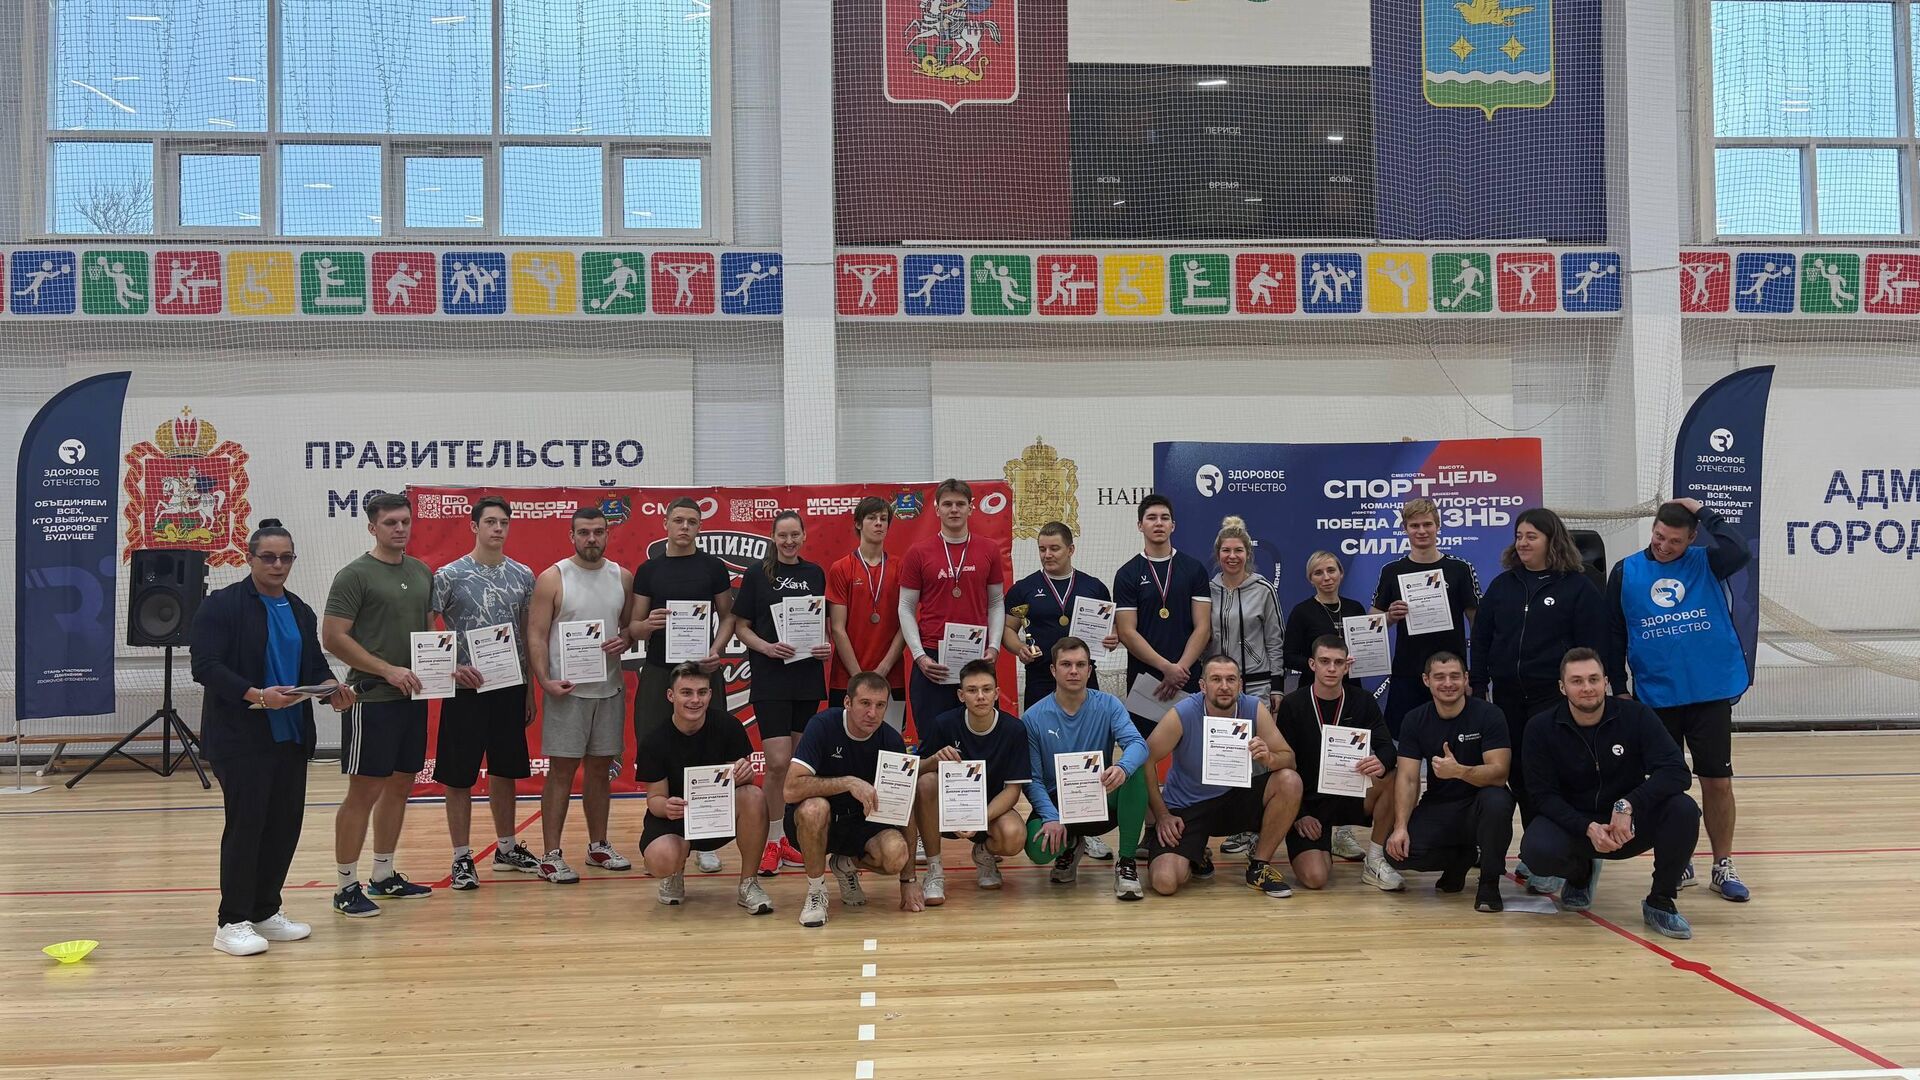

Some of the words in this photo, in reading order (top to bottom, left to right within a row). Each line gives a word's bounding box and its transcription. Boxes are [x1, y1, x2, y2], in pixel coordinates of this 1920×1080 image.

[1205, 126, 1241, 135] ПЕРИОД
[1209, 181, 1239, 189] ВРЕМЯ
[305, 440, 644, 469] ПРАВИТЕЛЬСТВО
[1696, 455, 1745, 464] ЗДОРОВОЕ
[44, 468, 99, 477] ЗДОРОВОЕ
[1695, 464, 1746, 473] ОТЕЧЕСТВО
[1228, 470, 1285, 480] ЗДОРОВОЕ
[1439, 471, 1497, 486] ЦЕЛЬ
[42, 479, 100, 487] ОТЕЧЕСТВО
[1227, 483, 1287, 492] ОТЕЧЕСТВО
[1323, 478, 1436, 499] СПОРТ
[1688, 484, 1752, 492] ОБЪЕДИНЯЕМ
[444, 496, 466, 504] ПРО
[1707, 492, 1732, 500] ВСЕХ,
[34, 499, 107, 508] ОБЪЕДИНЯЕМ
[807, 498, 861, 507] МОСОБ
[1361, 502, 1405, 510] КОМАНД
[1432, 496, 1524, 508] УПОРСТВО
[56, 507, 84, 515] ВСЕХ,
[442, 504, 472, 515] СПО
[642, 502, 668, 515] СМ
[510, 510, 564, 519] СПОРТ
[32, 517, 53, 525] КТО
[54, 516, 109, 524] ВЫБИРАЕТ
[1317, 518, 1390, 531] ПОБЕДА
[42, 524, 98, 533] ЗДОРОВОЕ
[45, 533, 95, 541] БУДУЩЕЕ
[1641, 608, 1707, 627] ЗДОРОВОЕ
[1642, 621, 1711, 639] ОТЕЧЕСТВО
